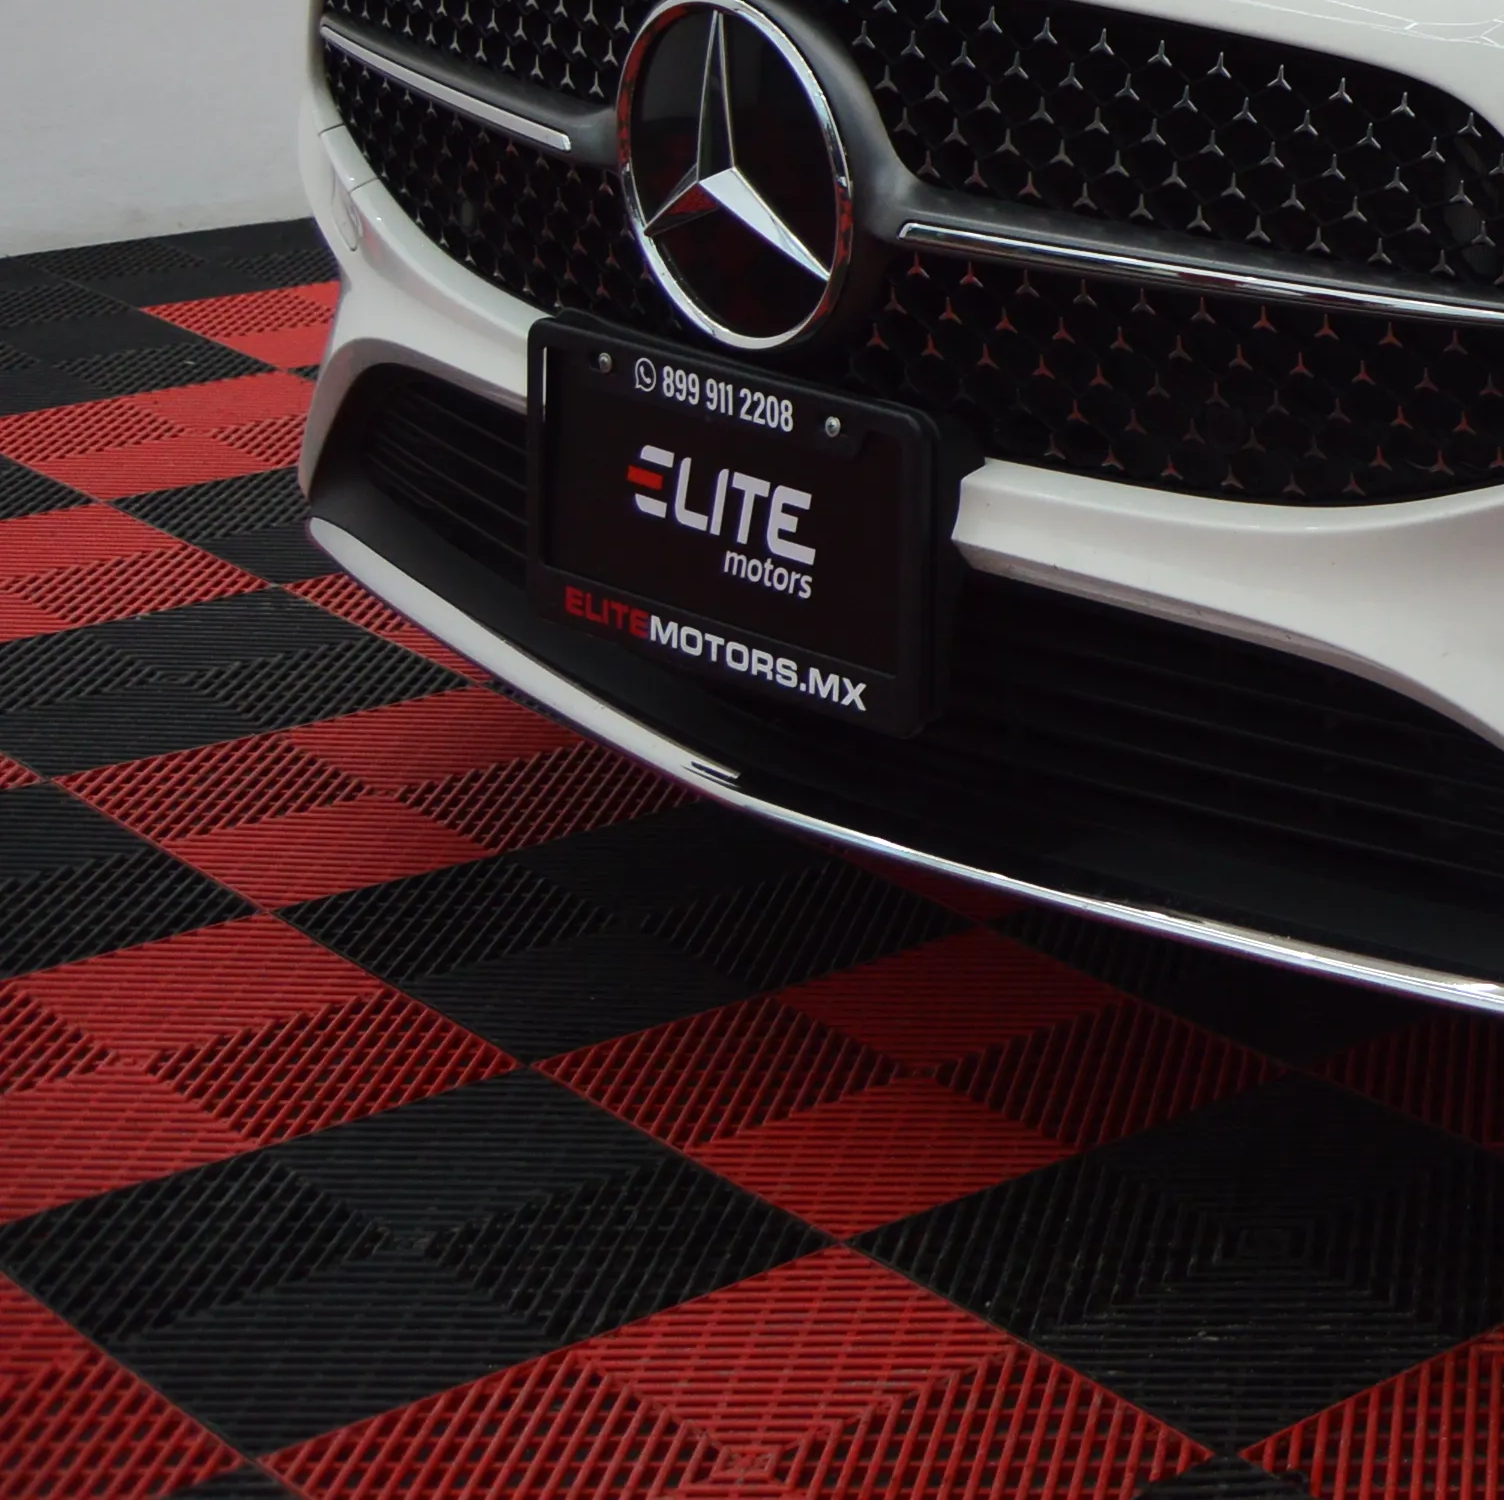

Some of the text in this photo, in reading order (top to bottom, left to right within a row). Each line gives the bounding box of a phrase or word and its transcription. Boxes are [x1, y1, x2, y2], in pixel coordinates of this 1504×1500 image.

[662, 365, 794, 433] 899 911 2208
[627, 444, 816, 565] ELITE
[723, 550, 813, 600] motors
[564, 585, 867, 712] ELITEMOTORS.MX
